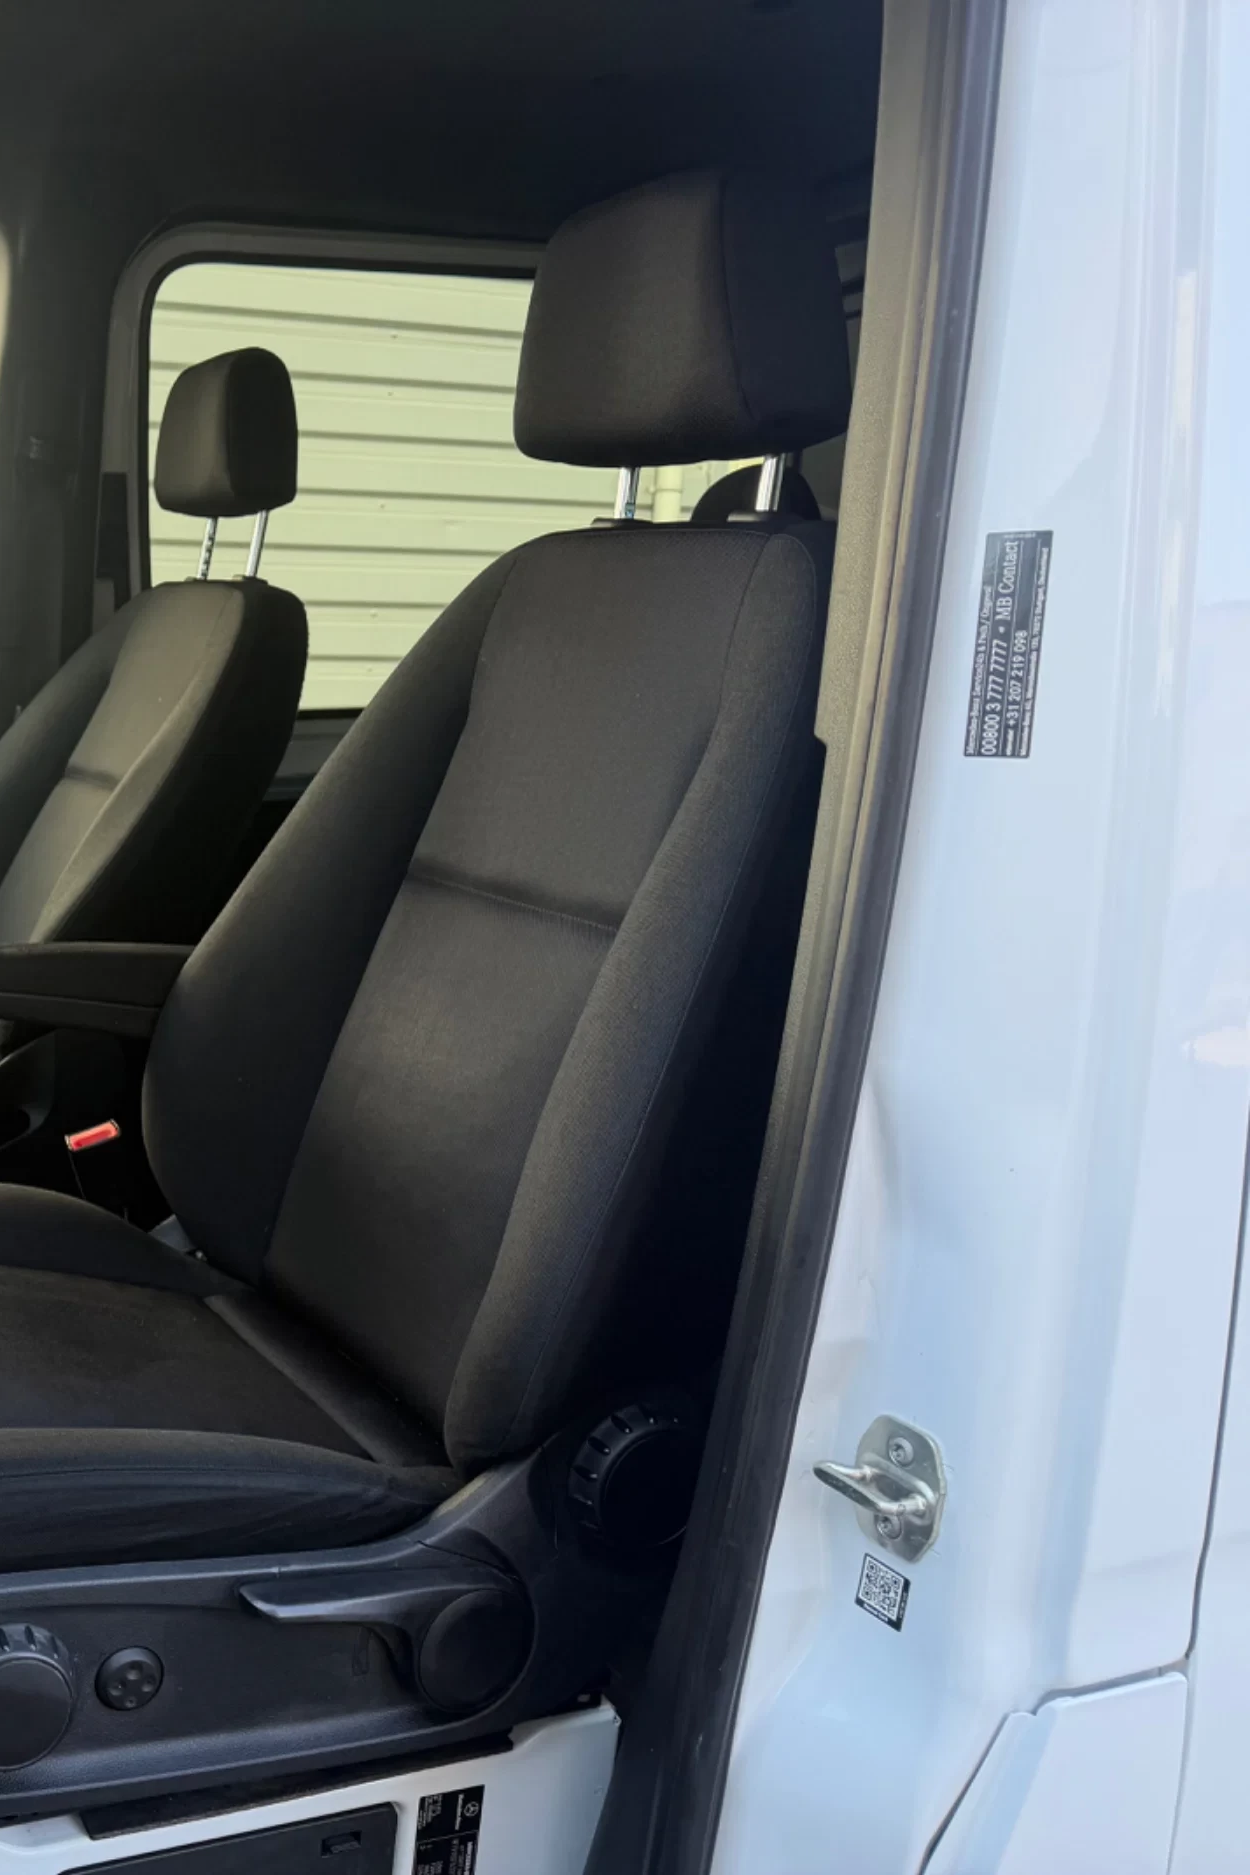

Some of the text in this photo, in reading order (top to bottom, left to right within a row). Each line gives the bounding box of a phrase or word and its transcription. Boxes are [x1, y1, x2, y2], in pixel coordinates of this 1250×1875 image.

[998, 541, 1019, 593] Contact
[995, 597, 1013, 620] MB
[1013, 630, 1028, 652] 098
[990, 640, 1008, 672] 7777
[1011, 655, 1025, 676] 219
[987, 676, 1004, 699] 777
[1009, 681, 1022, 701] 207
[1006, 706, 1019, 726] +31
[981, 715, 1000, 754] 00800
